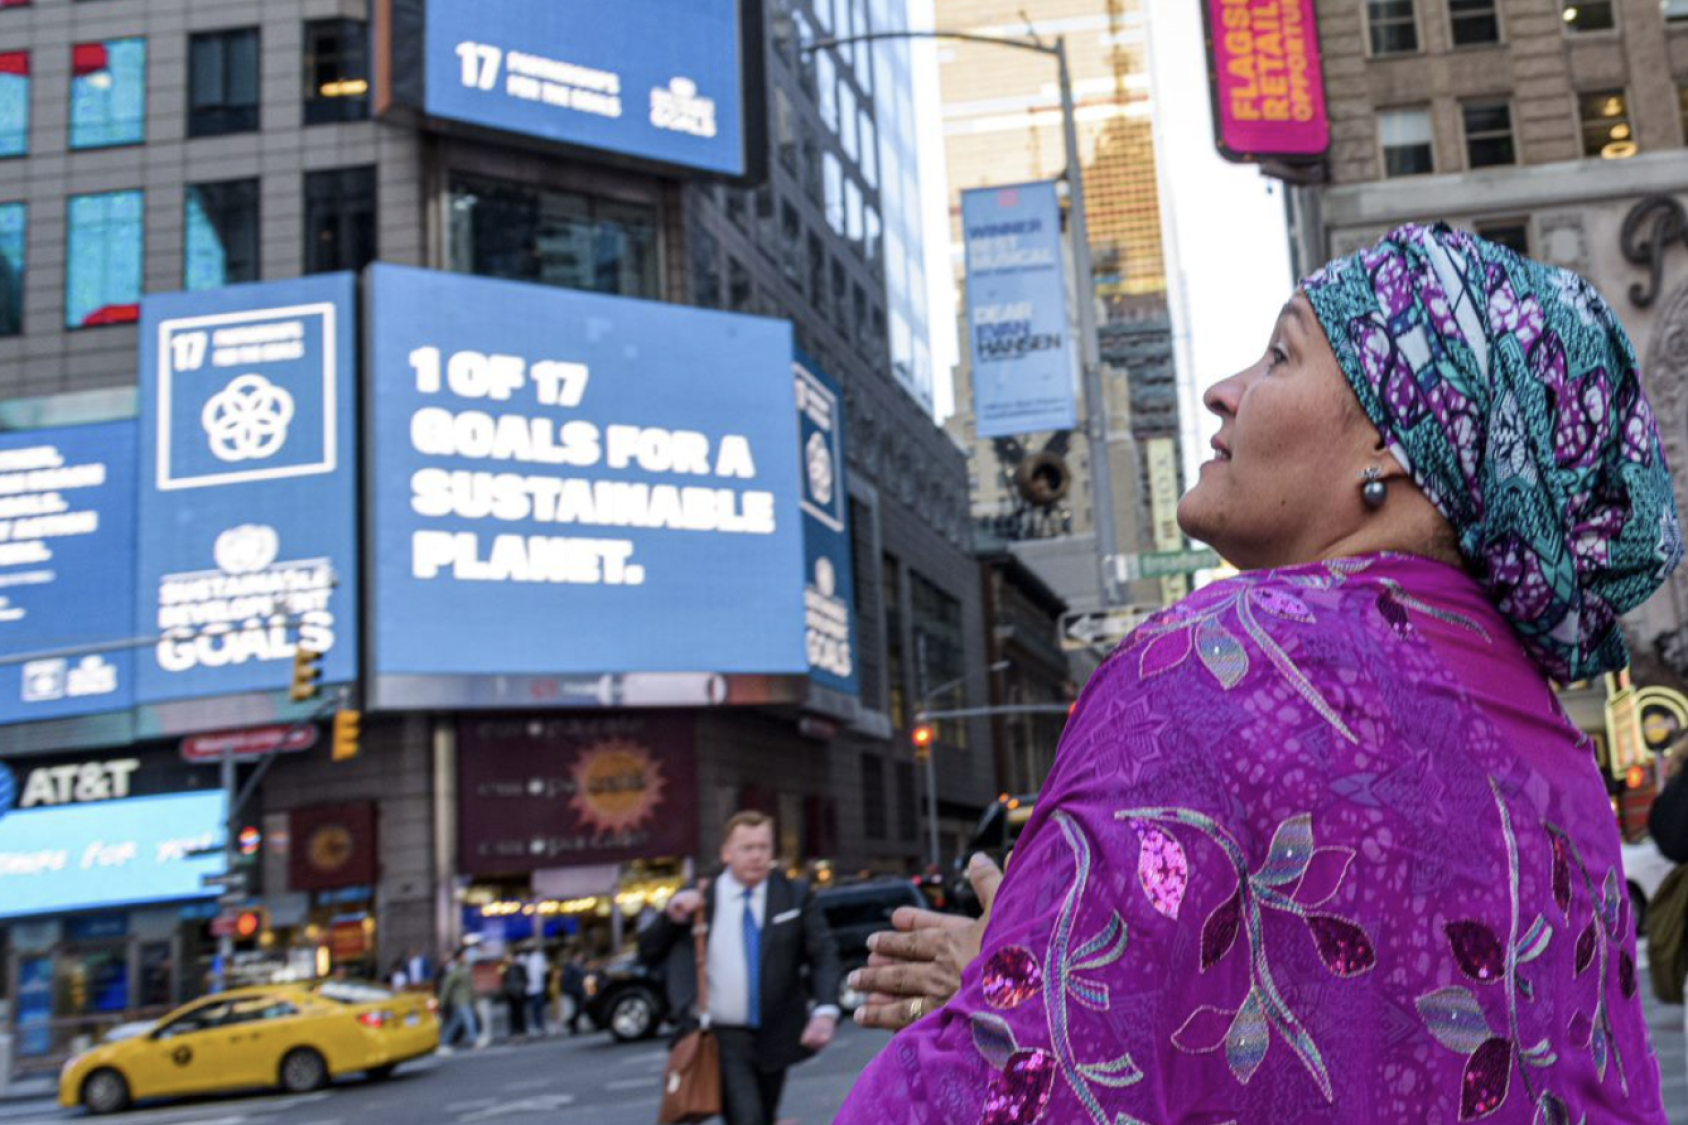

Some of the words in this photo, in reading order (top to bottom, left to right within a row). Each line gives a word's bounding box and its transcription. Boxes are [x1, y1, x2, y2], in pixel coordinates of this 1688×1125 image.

[455, 40, 502, 91] 17
[1252, 0, 1291, 121] RETAIL
[171, 330, 208, 370] 17
[409, 346, 440, 393] 1
[447, 351, 525, 400] OF
[530, 360, 589, 406] 17
[410, 408, 601, 466] GOALS
[606, 424, 710, 475] FOR
[716, 435, 756, 478] A
[411, 468, 777, 534] SUSTAINABLE
[412, 530, 646, 585] PLANET.
[157, 610, 336, 672] GOALS
[19, 758, 140, 808] AT&T
